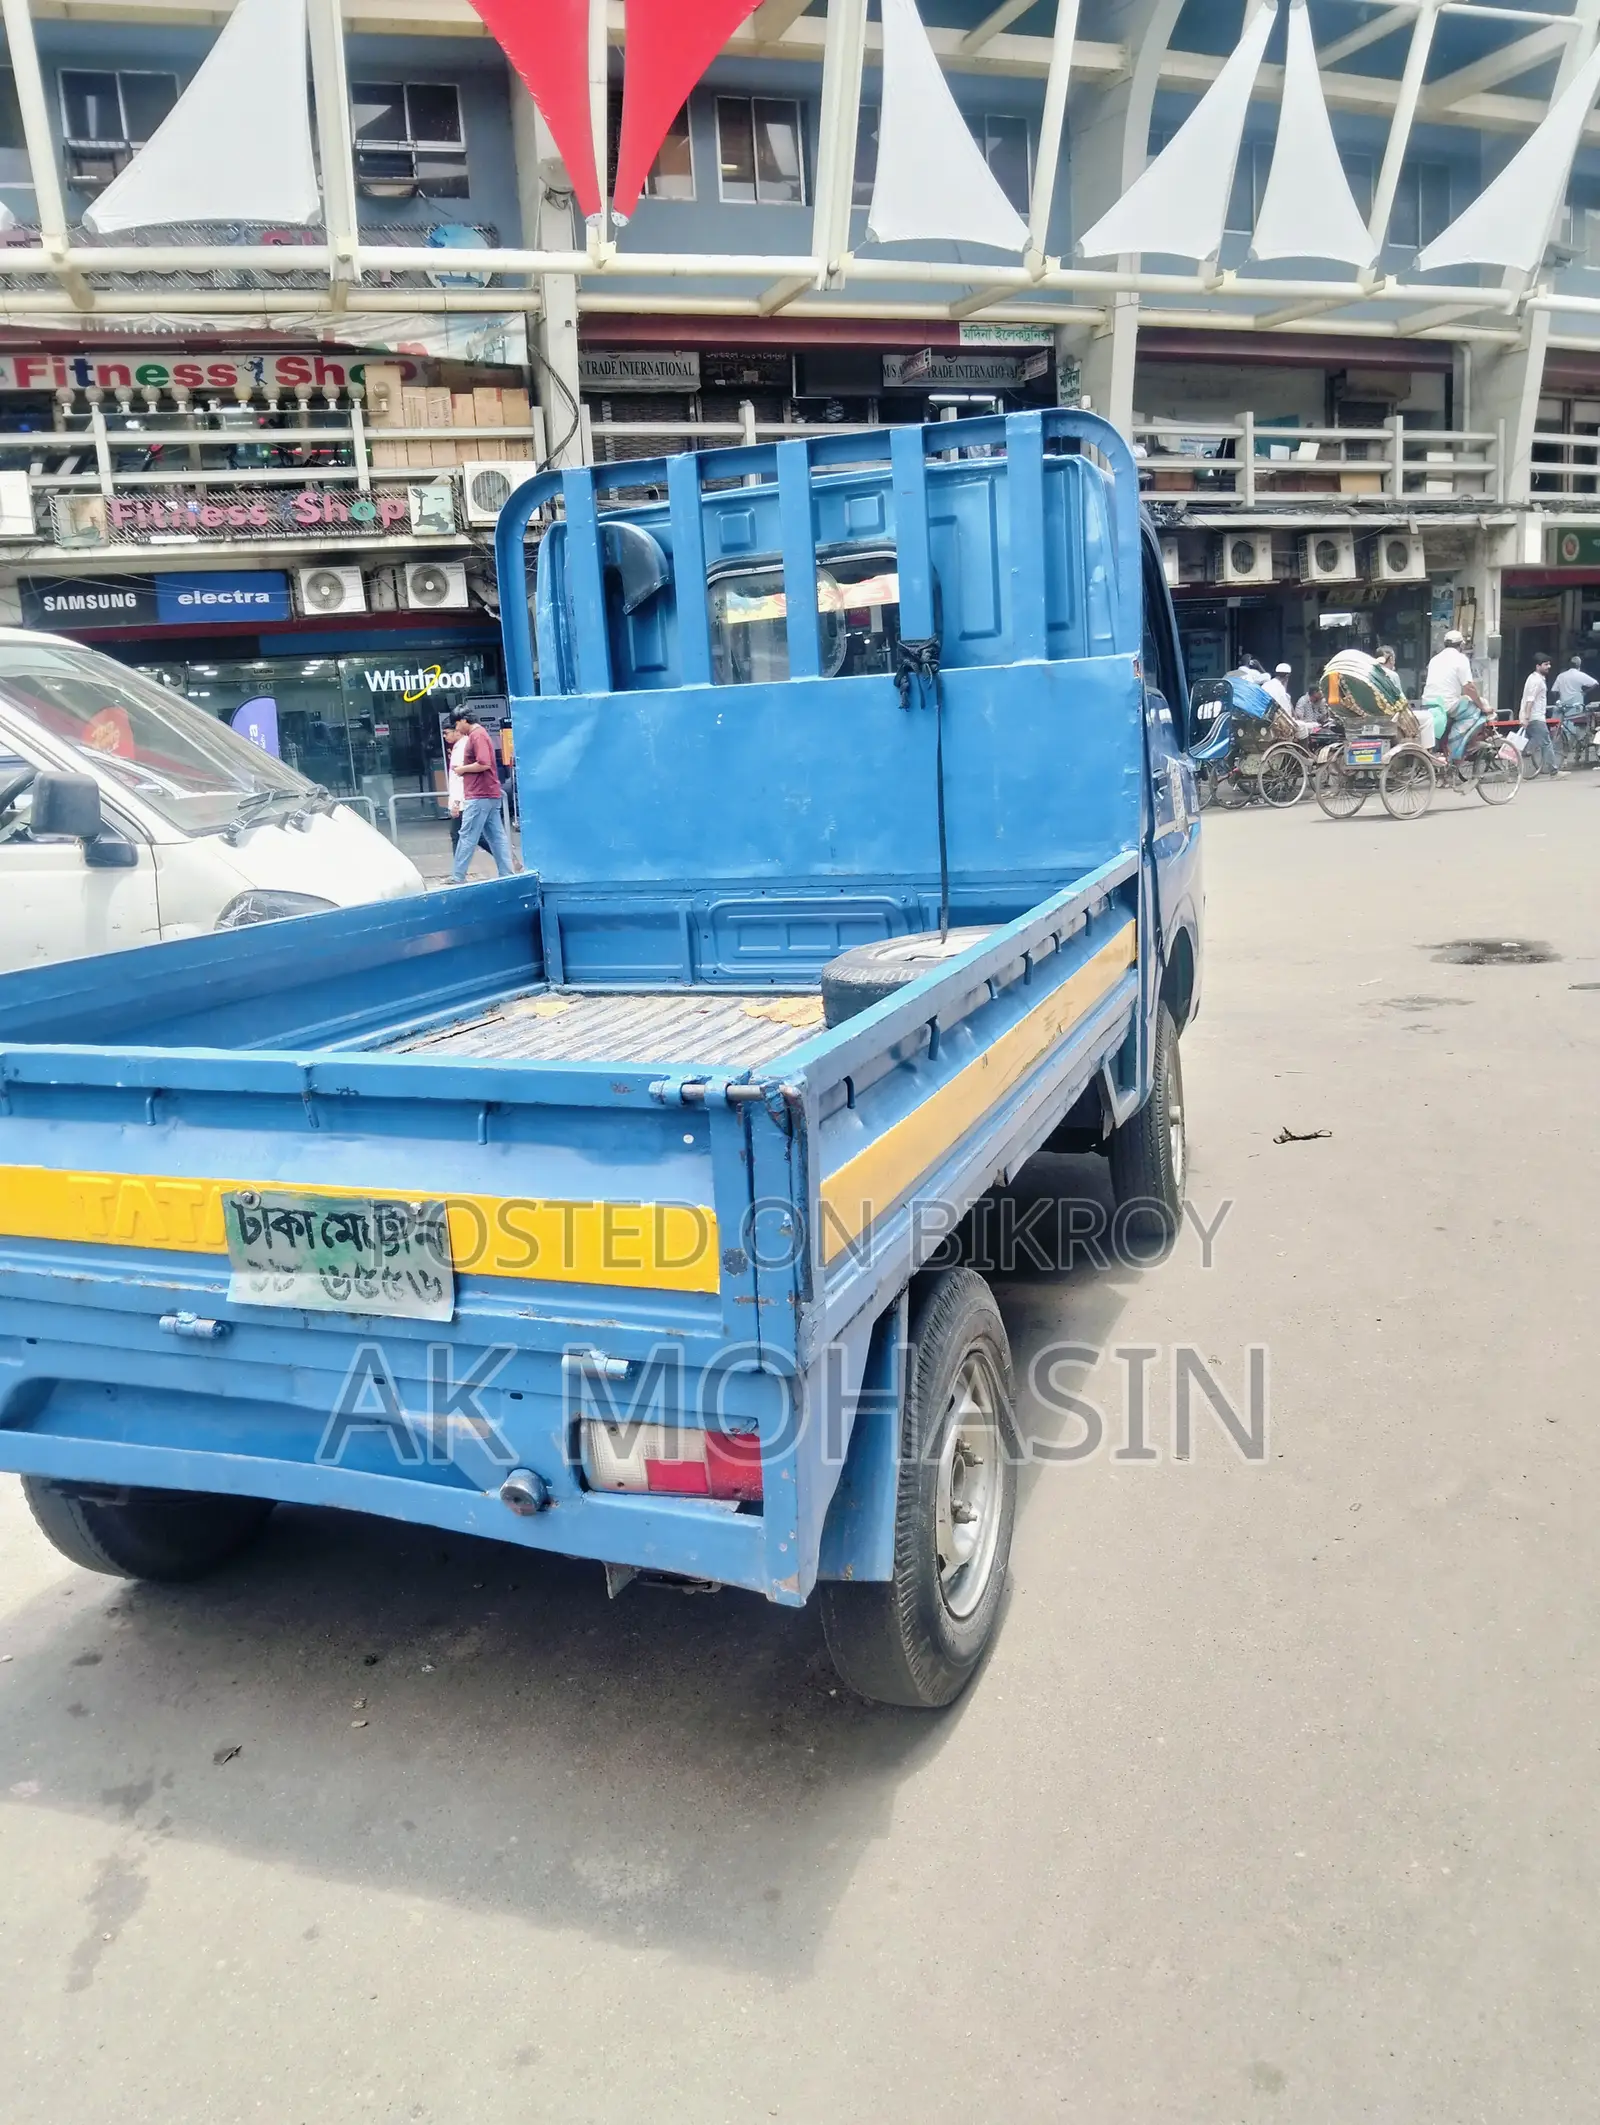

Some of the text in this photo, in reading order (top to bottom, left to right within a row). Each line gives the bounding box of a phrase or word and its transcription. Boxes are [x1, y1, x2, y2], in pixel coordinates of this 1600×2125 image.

[13, 356, 238, 388] Fitness
[585, 360, 618, 375] TRADE
[619, 360, 695, 377] INTERNATIONAL
[111, 492, 406, 528] Fitness Shop
[43, 592, 137, 612] SAMSUNG
[177, 589, 271, 606] electra
[364, 666, 471, 695] Whirlpool
[230, 1200, 318, 1250] ঢাকা
